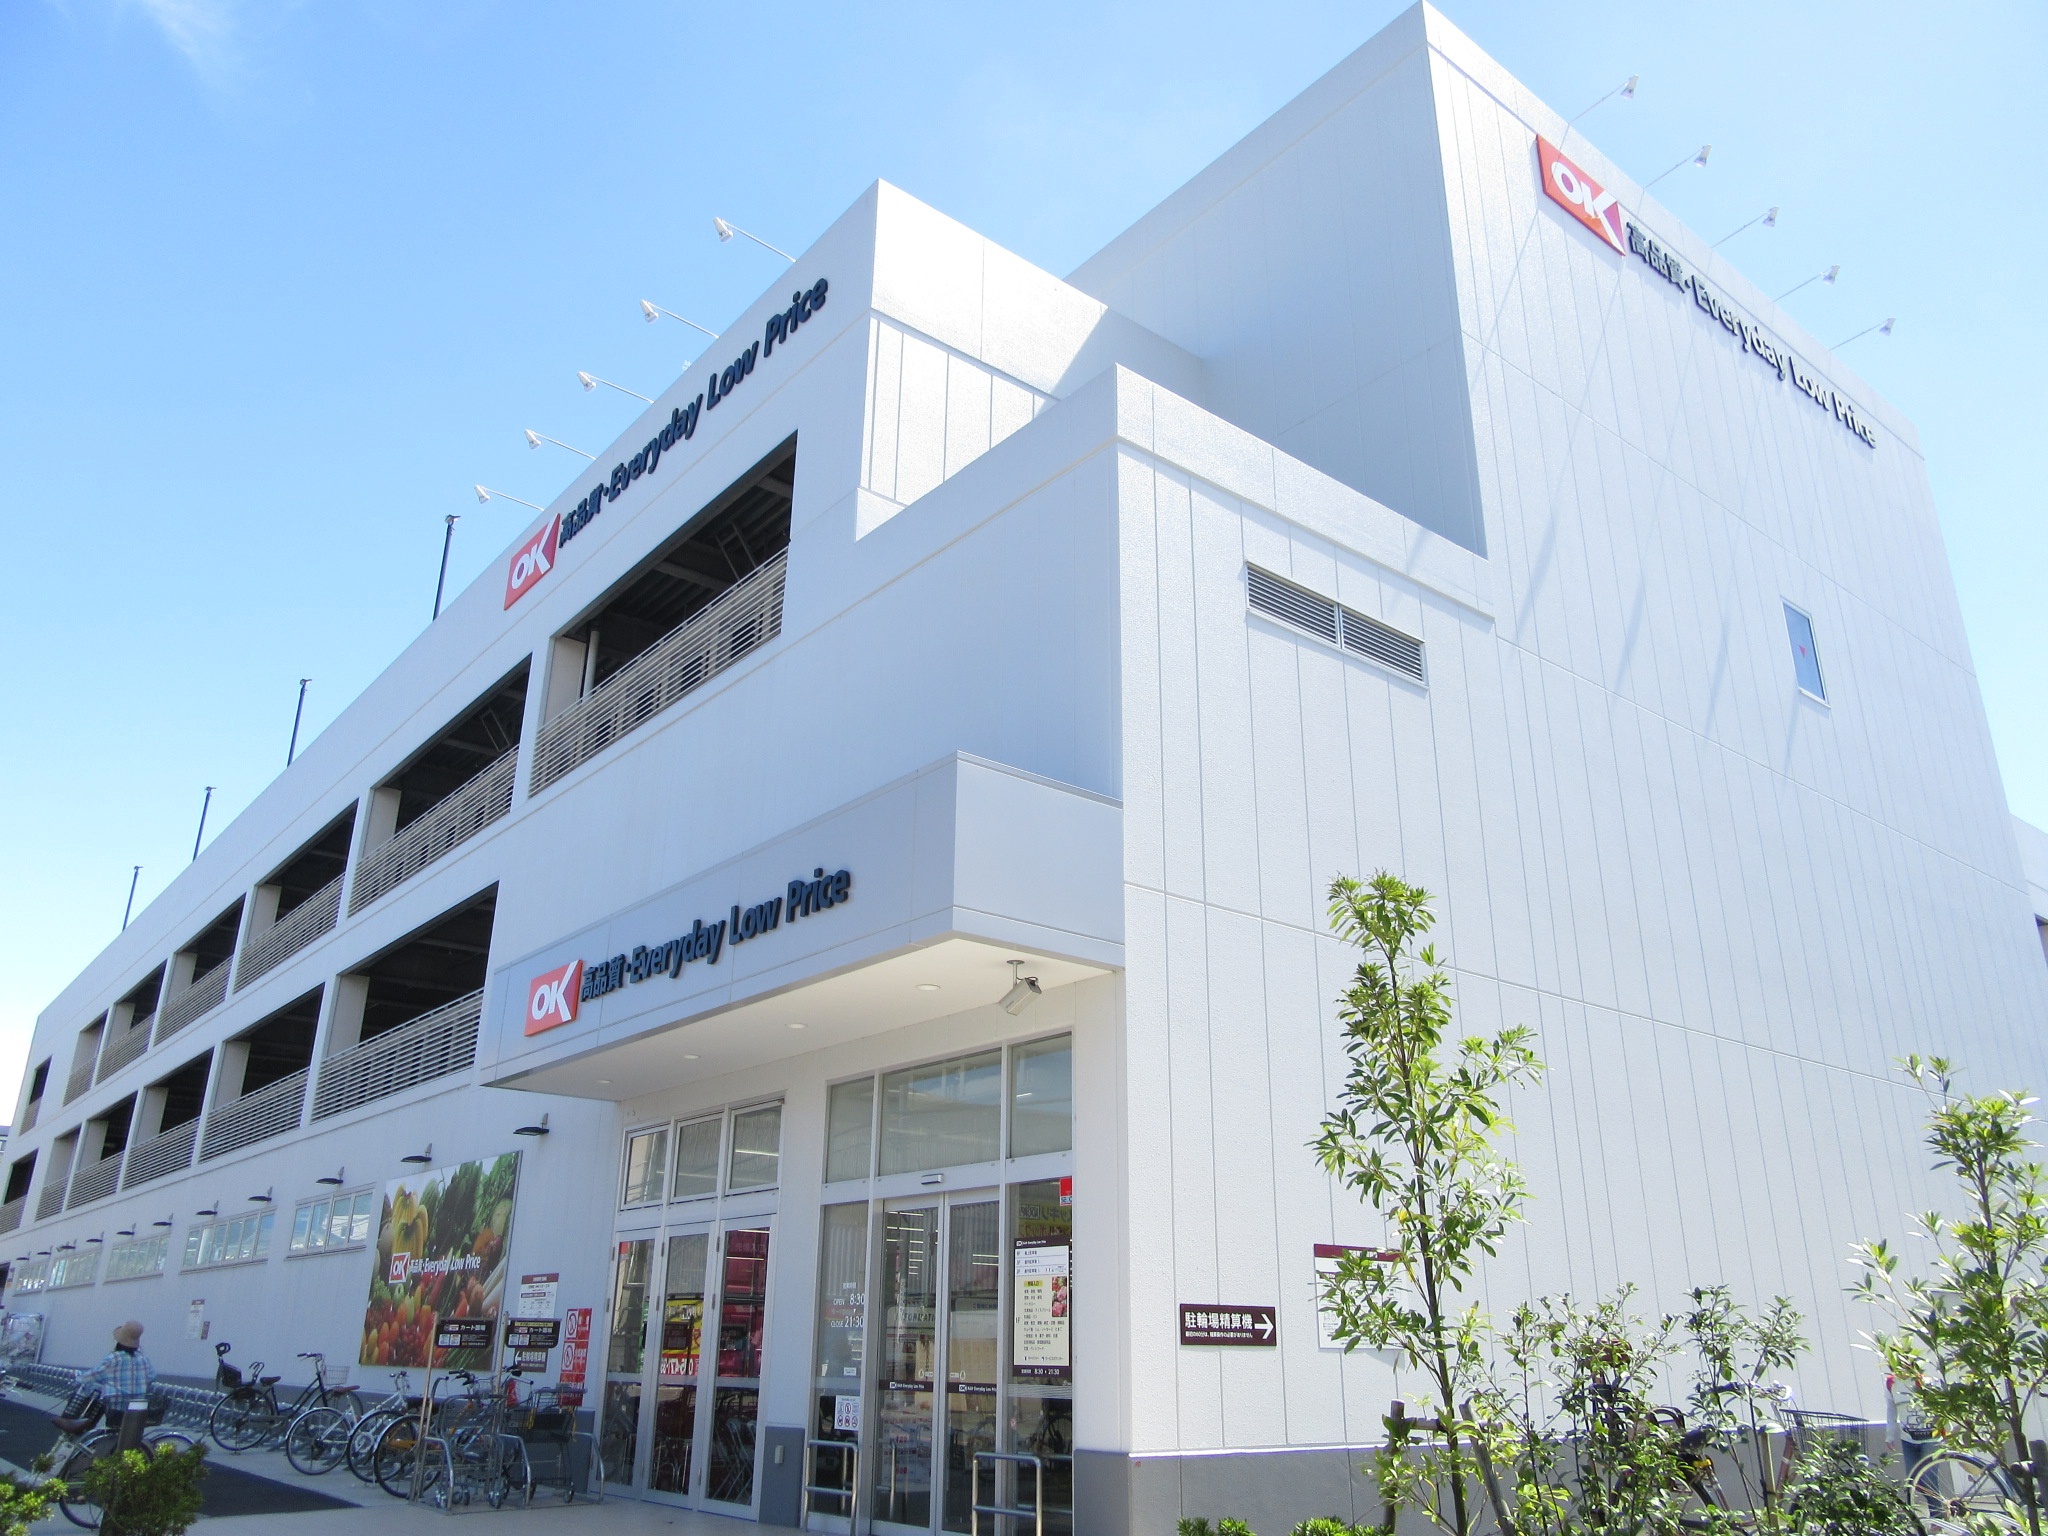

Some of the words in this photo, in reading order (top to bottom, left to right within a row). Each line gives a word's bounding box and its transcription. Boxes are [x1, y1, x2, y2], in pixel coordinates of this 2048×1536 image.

[1552, 162, 1625, 254] OK
[1789, 356, 1830, 412] Low
[1833, 392, 1877, 448] Price
[511, 514, 559, 589] OK
[707, 341, 759, 410] Low
[764, 278, 828, 357] Price
[531, 960, 580, 1023] OK
[729, 897, 781, 945] Low
[786, 868, 851, 923] Price
[450, 1255, 465, 1271] Low
[465, 1253, 481, 1269] Price
[850, 1292, 865, 1305] 8:30
[845, 1315, 864, 1328] 21:30
[1185, 1312, 1253, 1329] 駐輪場精算機
